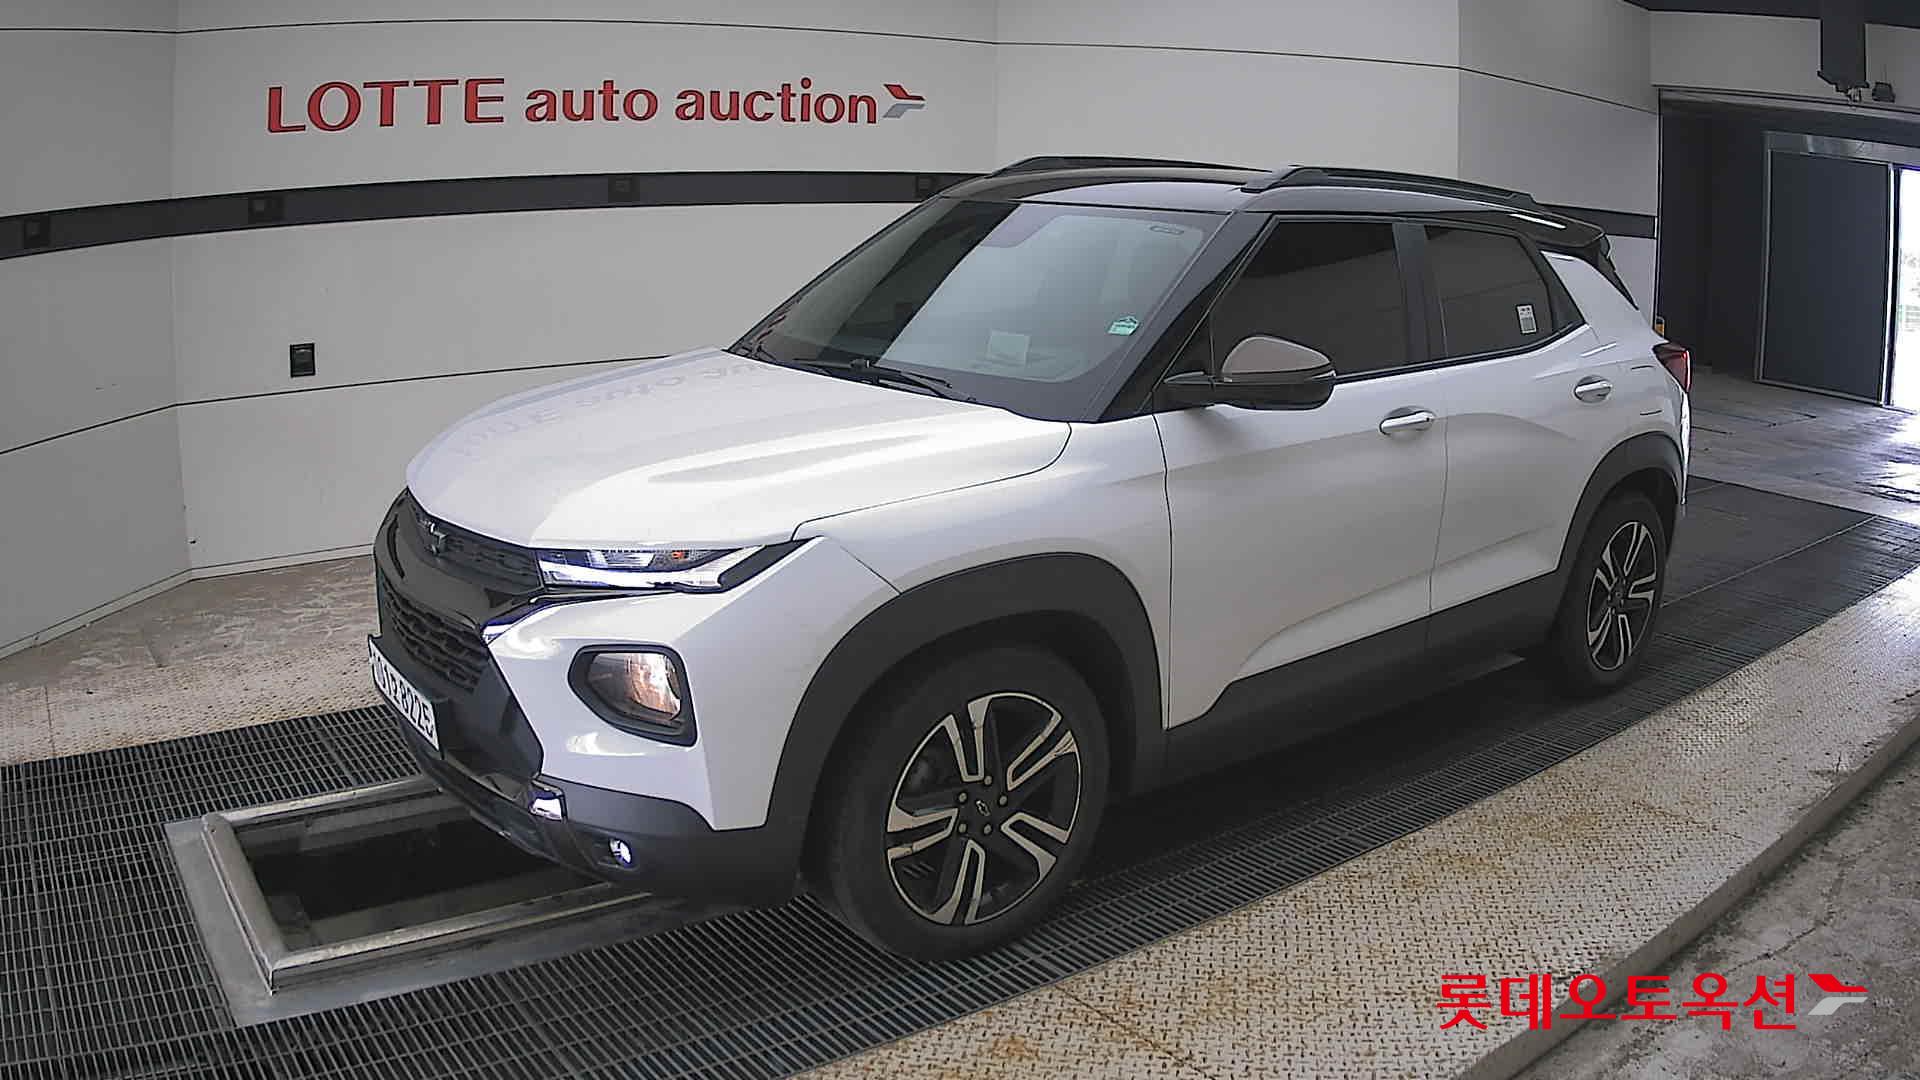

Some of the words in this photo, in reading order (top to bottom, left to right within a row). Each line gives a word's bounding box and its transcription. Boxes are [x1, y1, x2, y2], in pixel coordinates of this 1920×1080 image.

[267, 78, 504, 133] LOTTE
[525, 80, 659, 123] auto
[675, 78, 879, 124] auction
